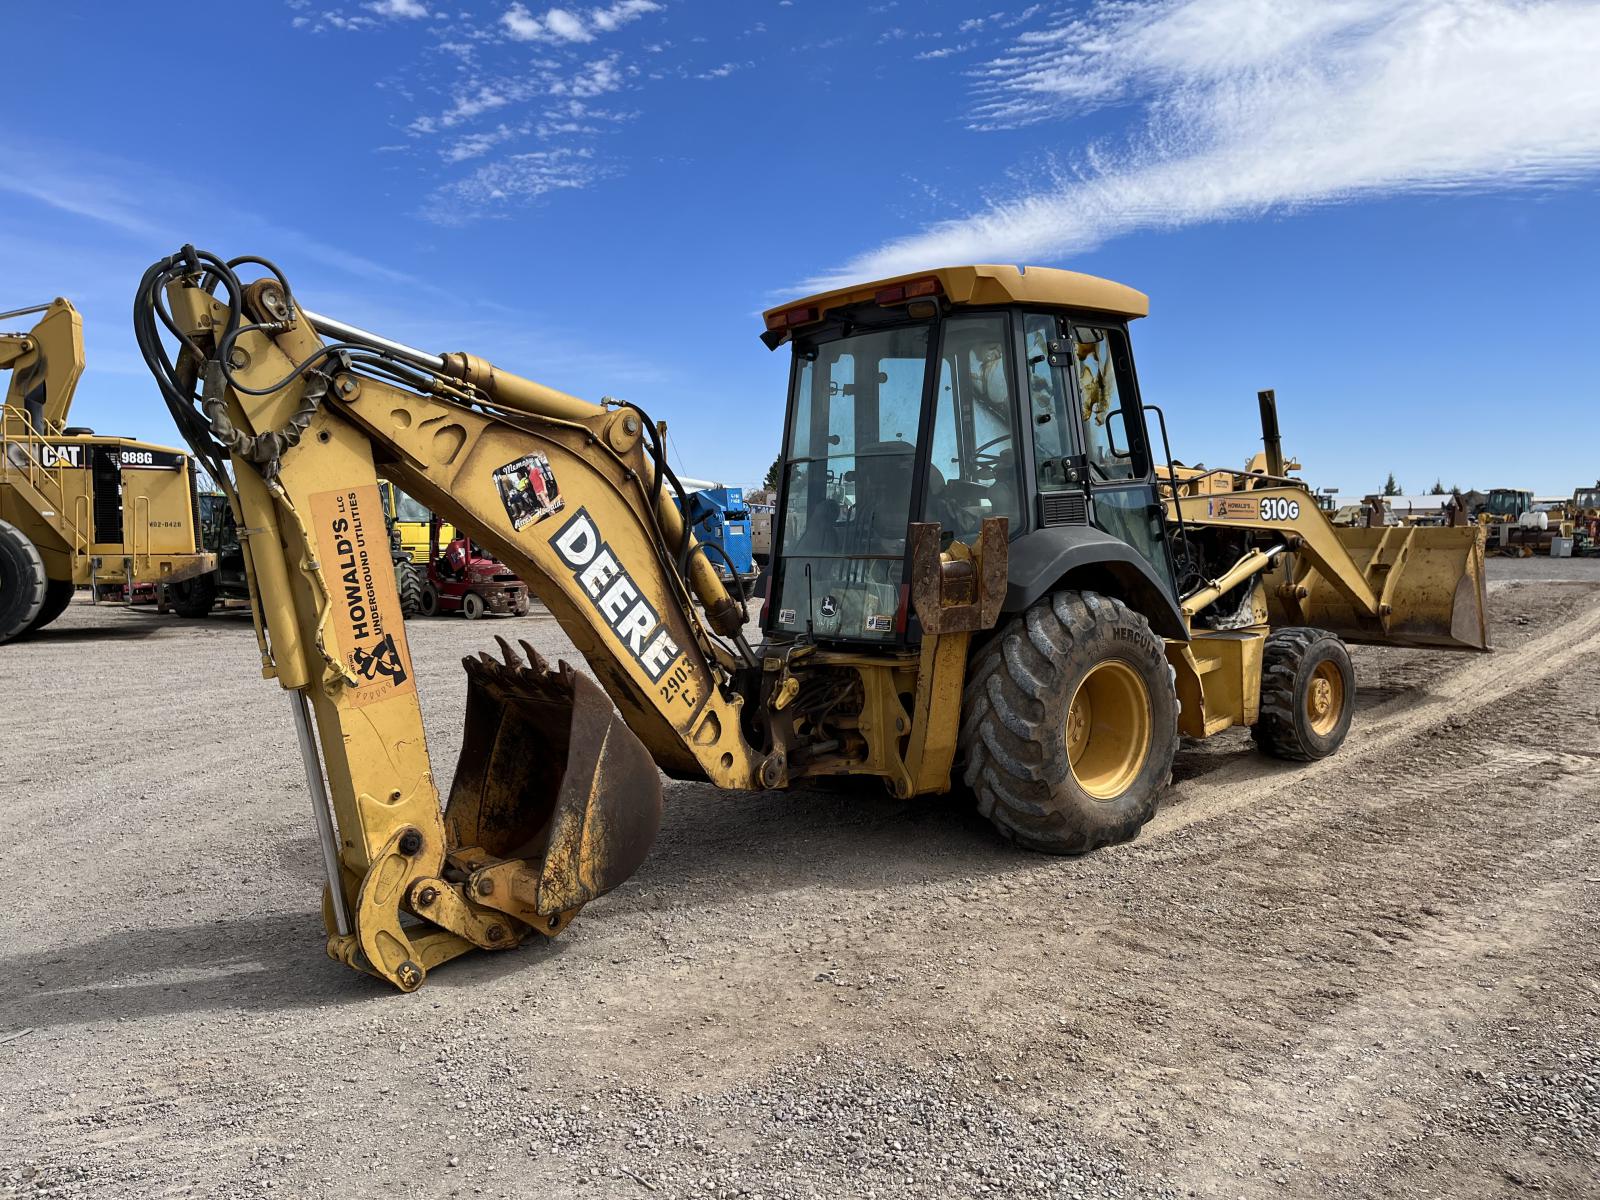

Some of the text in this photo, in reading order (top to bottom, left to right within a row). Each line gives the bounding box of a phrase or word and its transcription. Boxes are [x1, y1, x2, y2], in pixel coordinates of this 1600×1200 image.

[42, 446, 81, 467] CAT
[121, 451, 153, 465] 988G
[1260, 498, 1300, 520] 310G
[332, 495, 370, 640] HOWALD'S LLC
[348, 492, 383, 636] UNDERGROUND UTILITIES
[554, 513, 680, 678] DEERE
[660, 656, 695, 703] 2903
